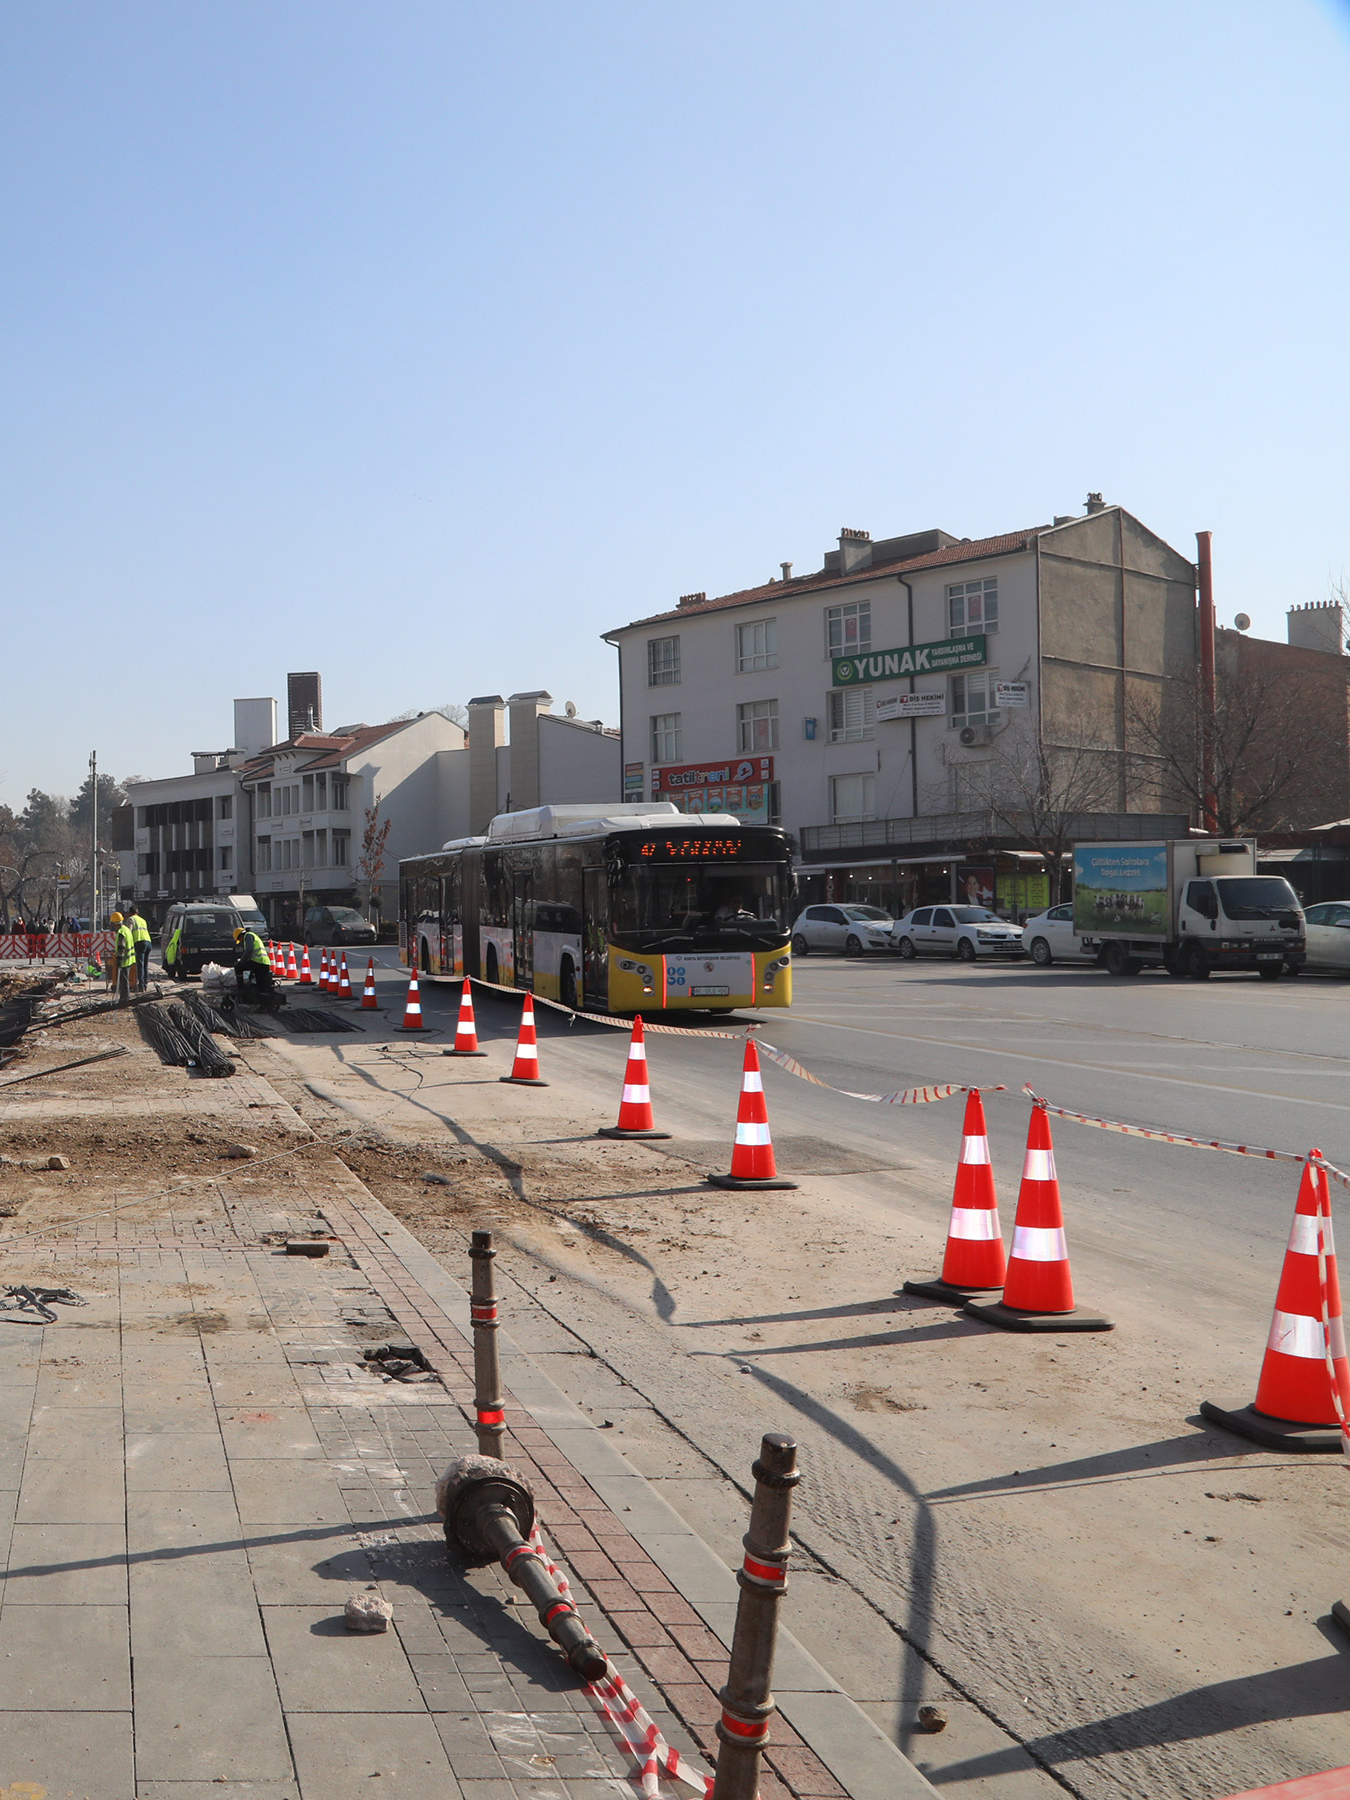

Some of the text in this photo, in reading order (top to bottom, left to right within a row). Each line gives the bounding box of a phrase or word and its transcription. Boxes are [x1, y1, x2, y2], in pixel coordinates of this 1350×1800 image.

[931, 642, 974, 657] YARDIMLAŞMA VE
[853, 648, 931, 679] YUNAK
[931, 652, 983, 668] DAYANIŞMA DERNEĞİ
[921, 693, 945, 702] HEKİMİ
[668, 767, 731, 786] tatiltreni
[1120, 857, 1150, 867] Sofralara
[1120, 868, 1141, 877] Lezzet
